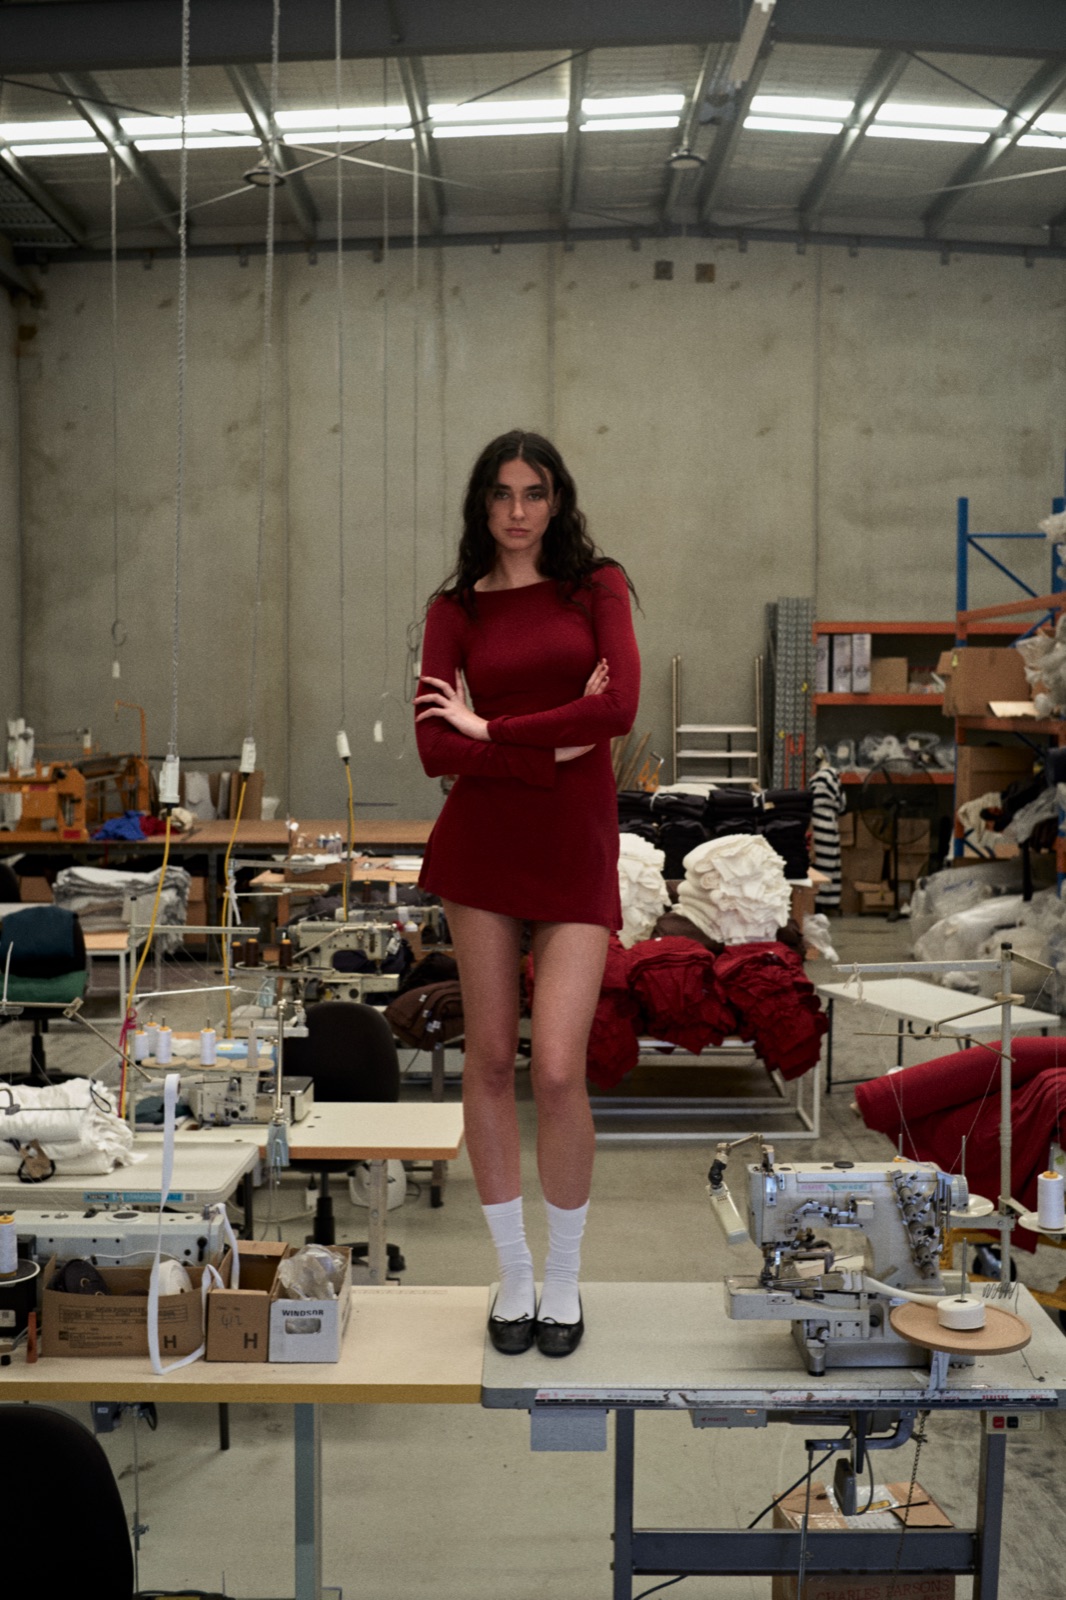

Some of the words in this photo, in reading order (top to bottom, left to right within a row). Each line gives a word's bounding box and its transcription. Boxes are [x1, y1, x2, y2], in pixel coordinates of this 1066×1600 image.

[282, 1309, 324, 1317] WINDSOR
[164, 1335, 177, 1348] H
[244, 1333, 258, 1349] H
